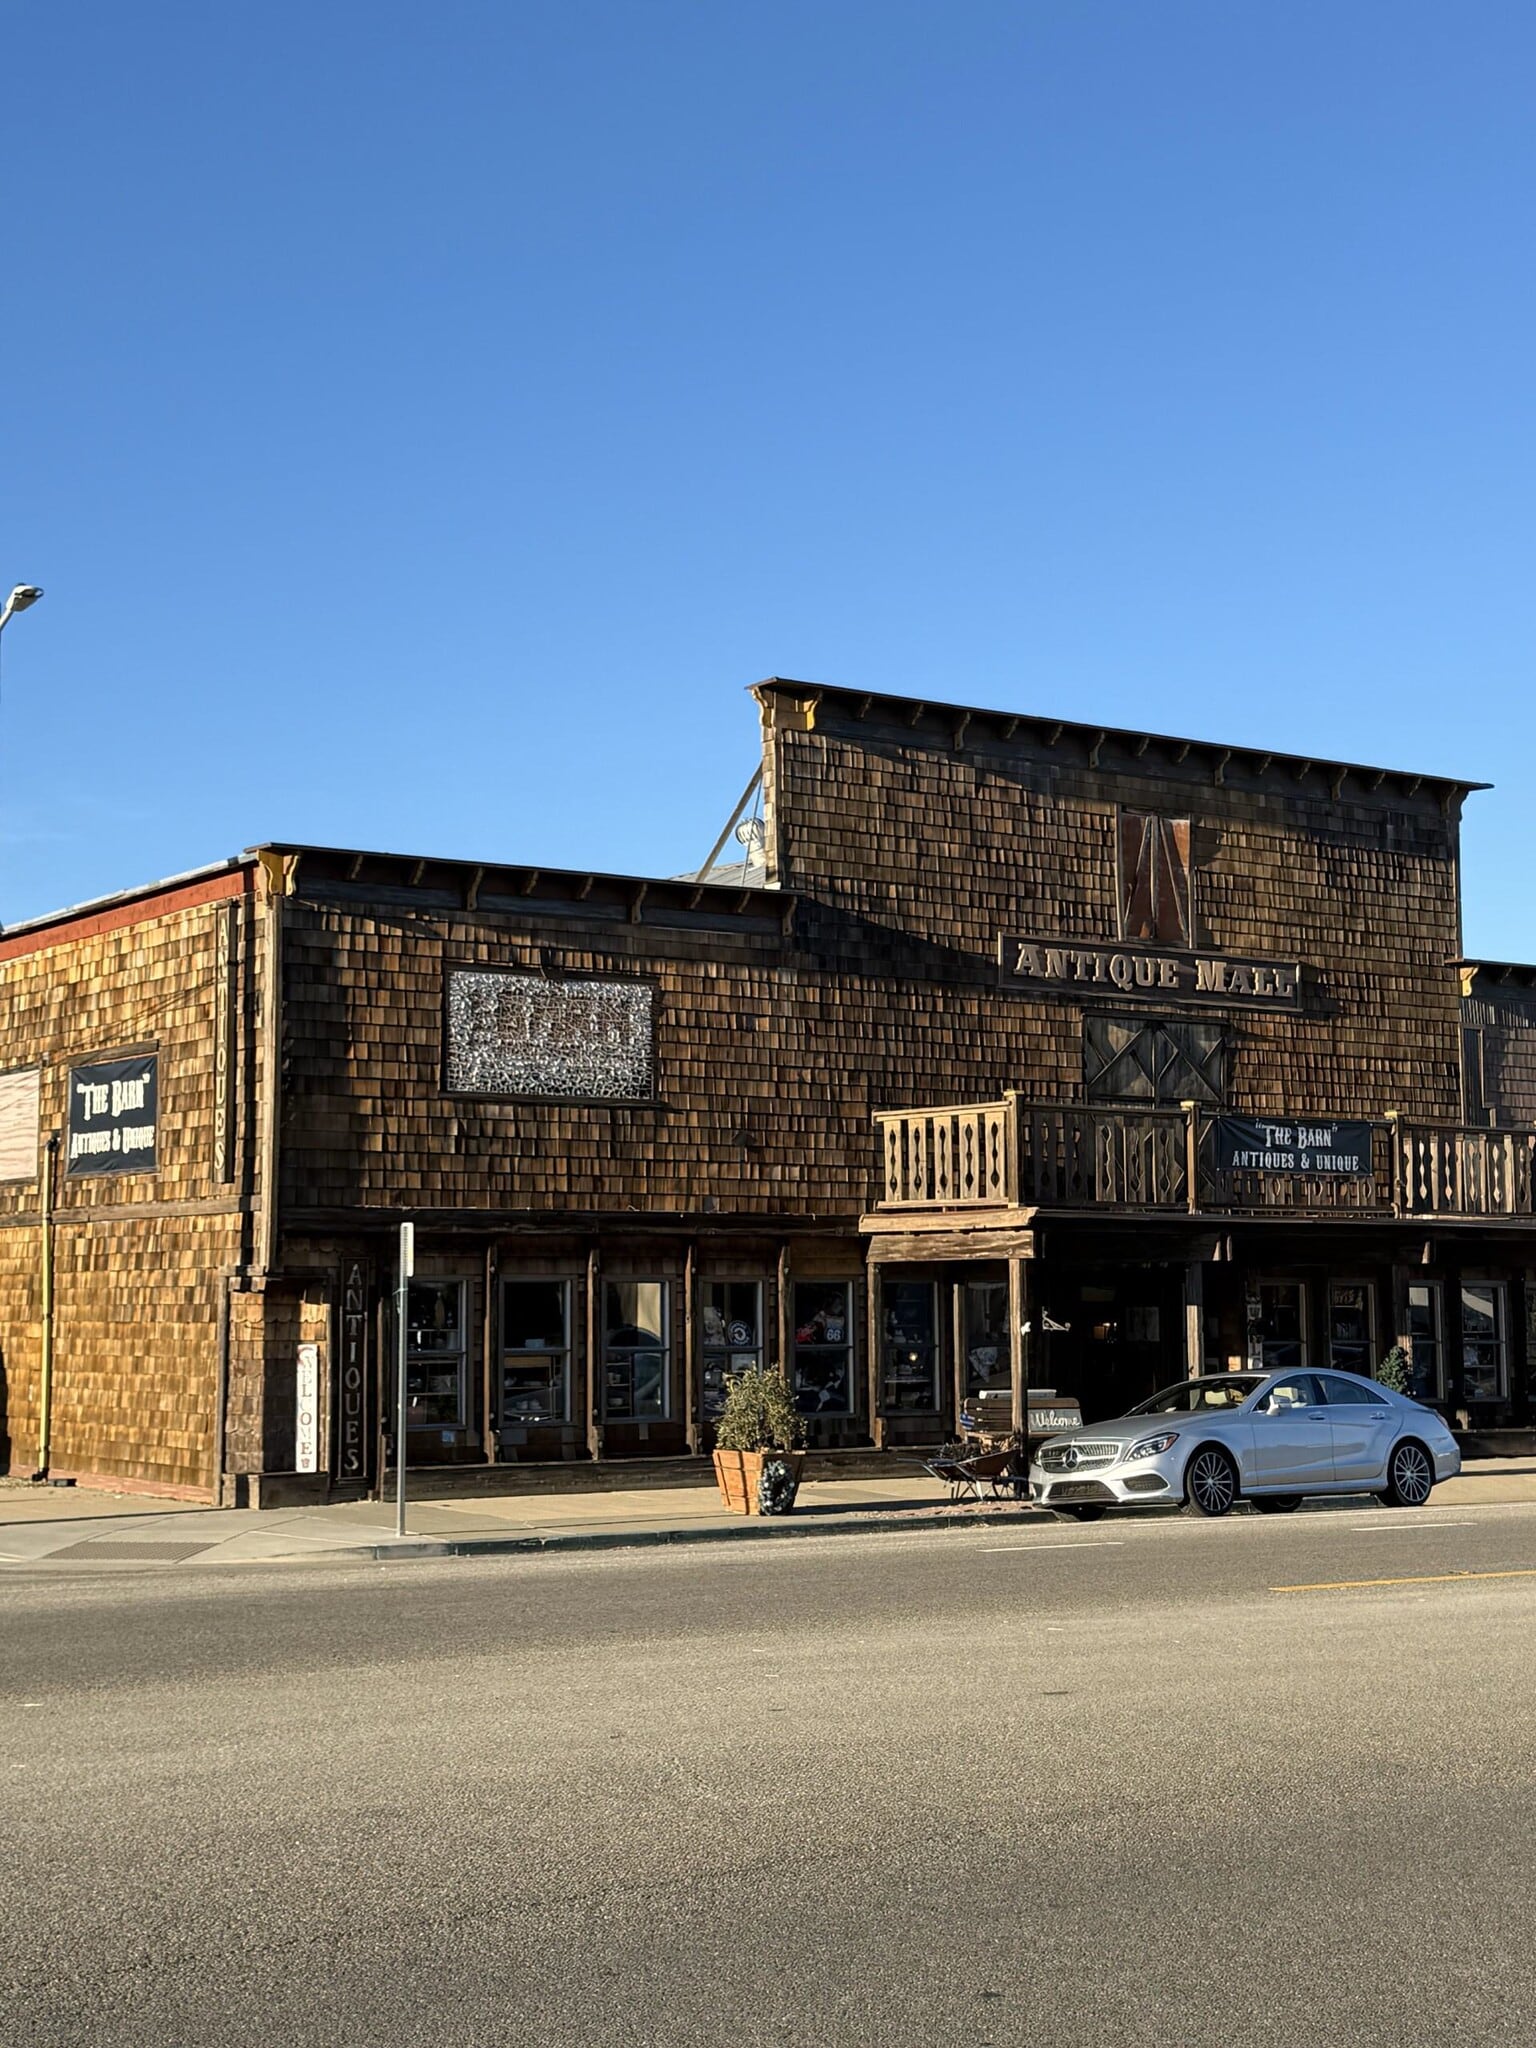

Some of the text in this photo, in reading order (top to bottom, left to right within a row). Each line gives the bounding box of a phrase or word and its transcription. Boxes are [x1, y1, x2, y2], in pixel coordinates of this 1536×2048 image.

[1013, 943, 1293, 997] ANTIQUE MALL
[112, 1128, 121, 1151] &
[1232, 1151, 1359, 1171] ANTIQUES & UNIQUE
